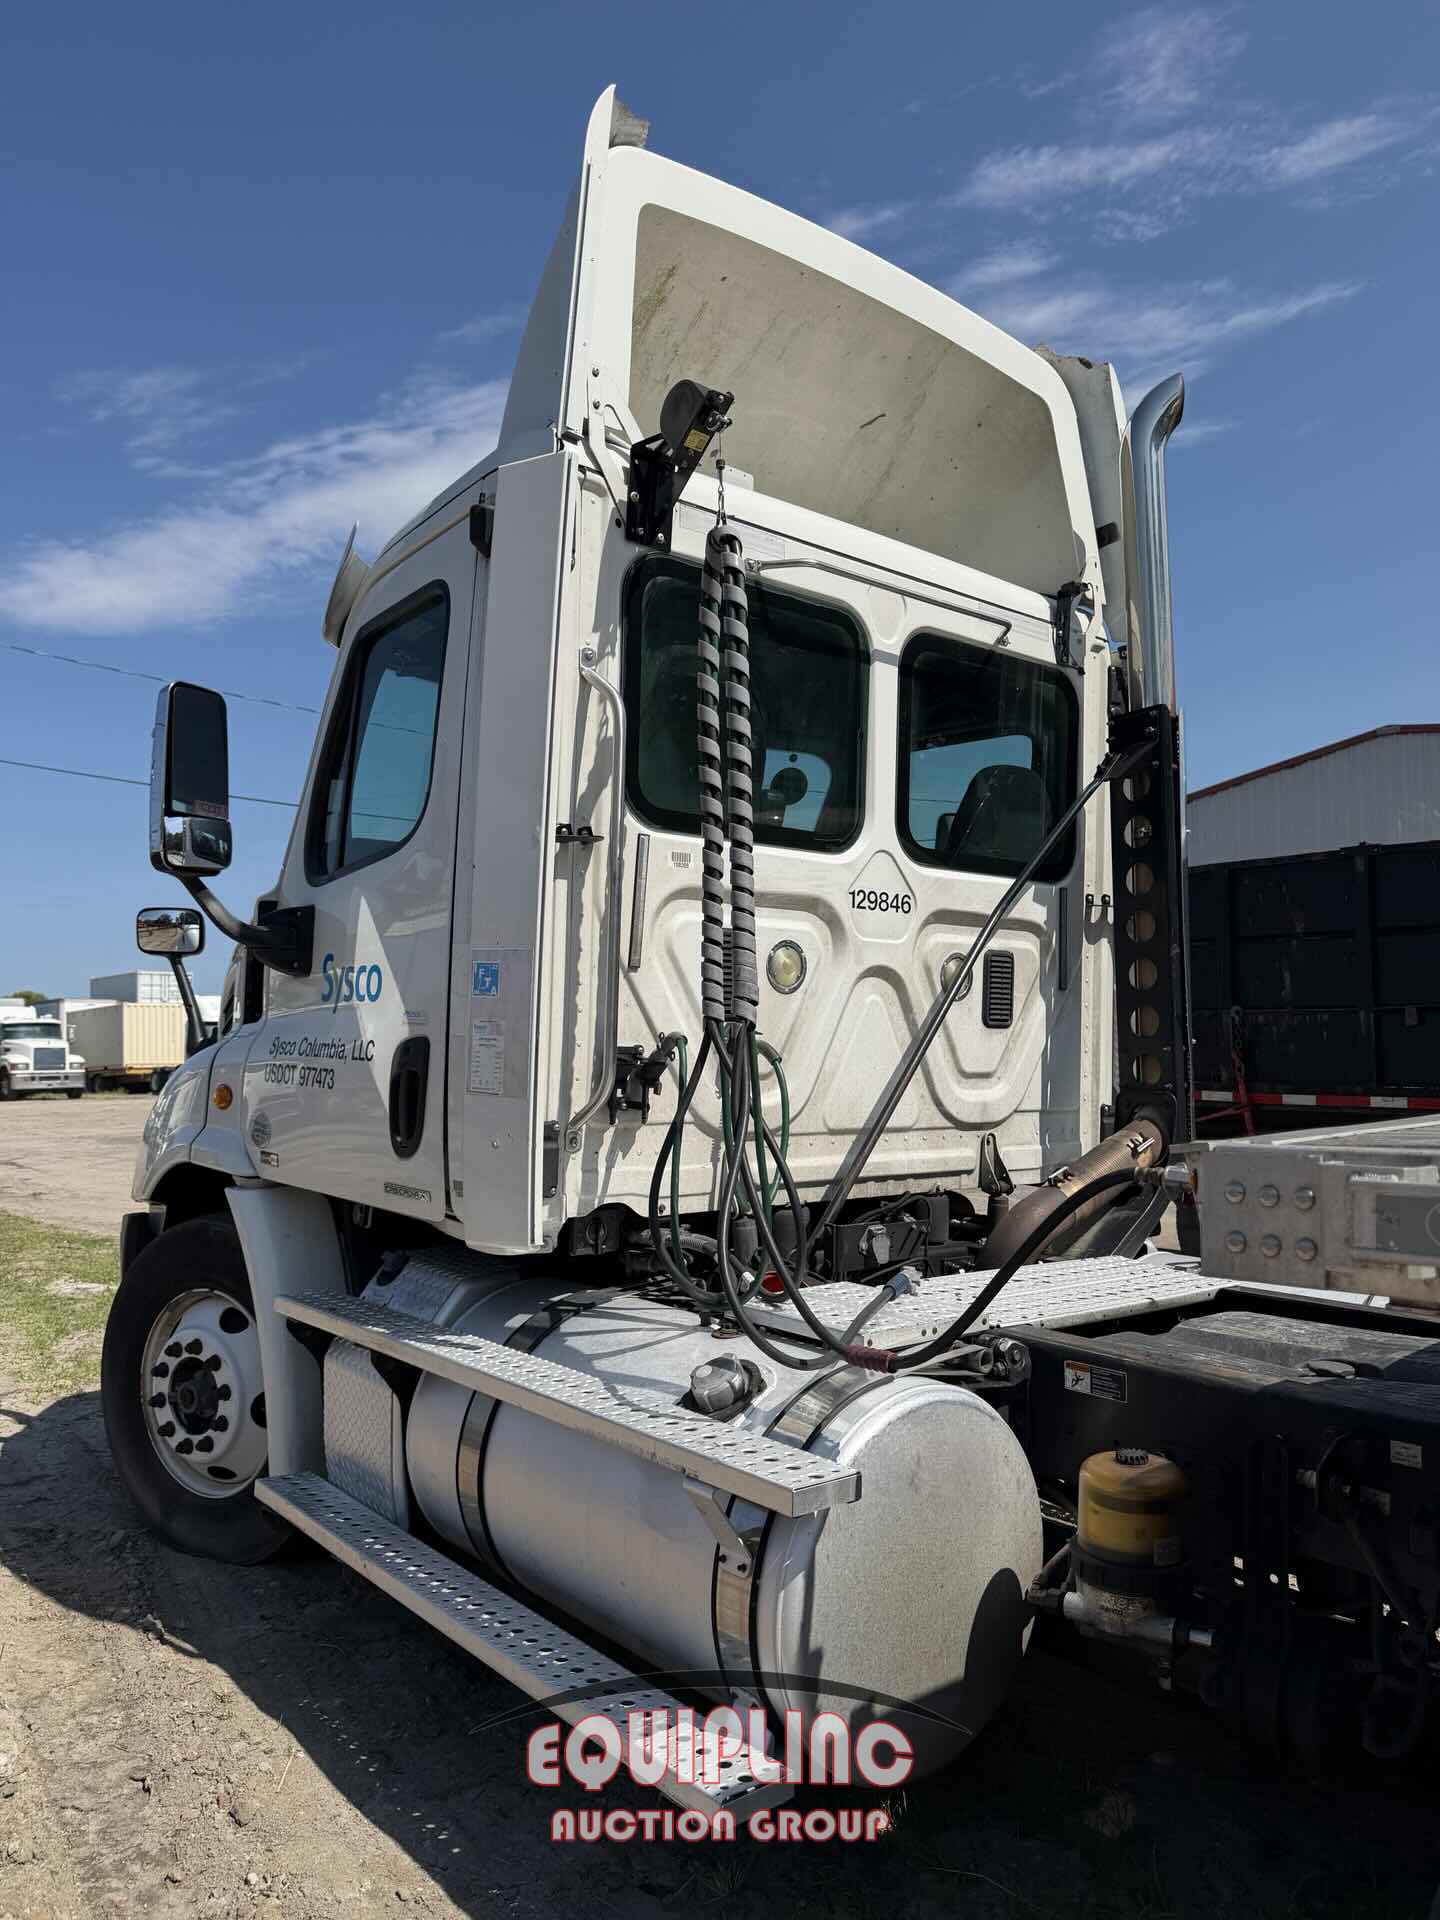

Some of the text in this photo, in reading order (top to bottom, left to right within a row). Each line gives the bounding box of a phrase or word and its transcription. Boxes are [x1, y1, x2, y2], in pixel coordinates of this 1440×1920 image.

[848, 889, 912, 914] 129846
[321, 953, 383, 1013] Sysco
[270, 1036, 376, 1064] Sysco Columbia, LLC
[265, 1063, 335, 1090] USDOT 977473
